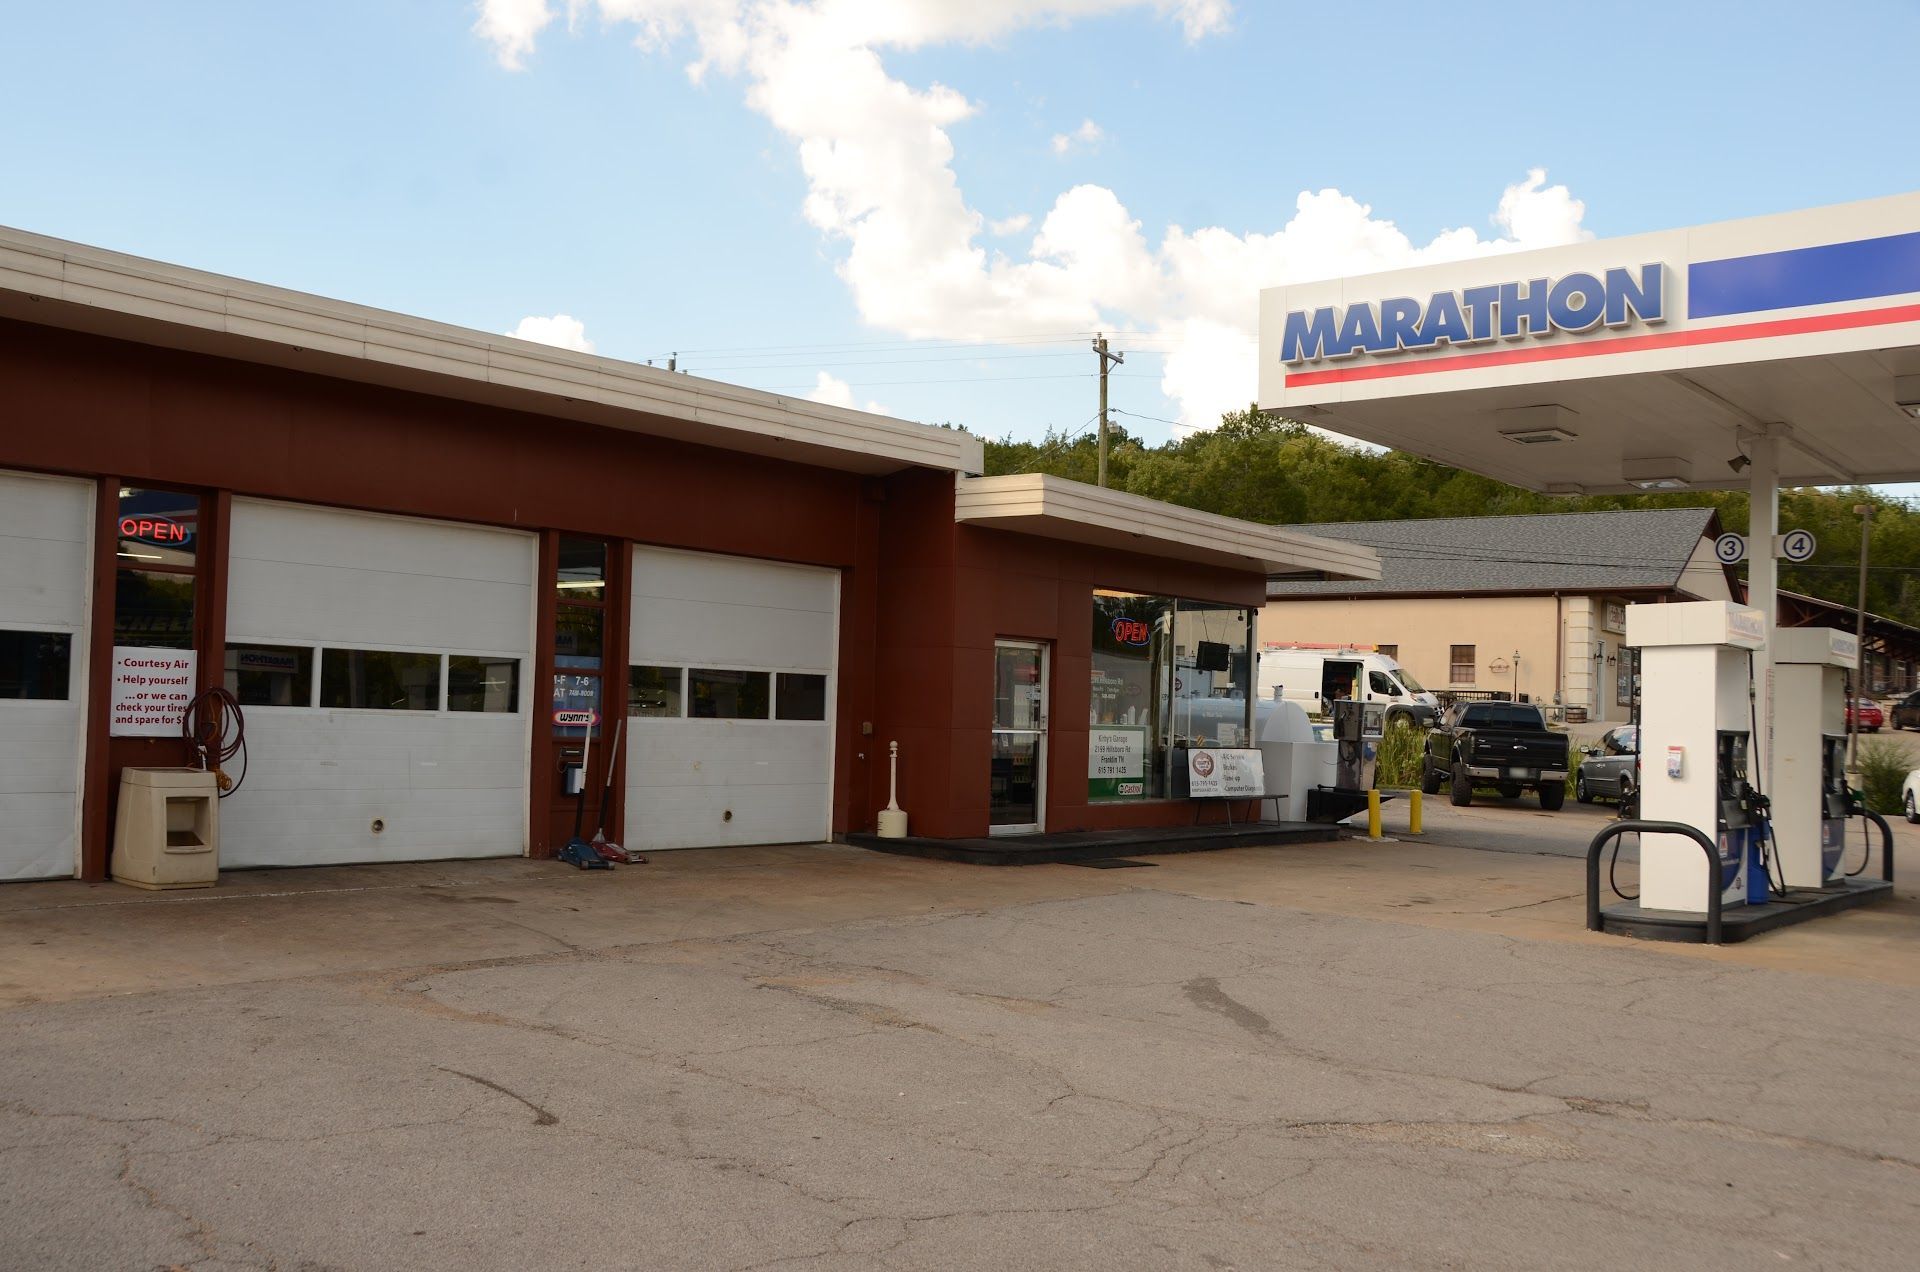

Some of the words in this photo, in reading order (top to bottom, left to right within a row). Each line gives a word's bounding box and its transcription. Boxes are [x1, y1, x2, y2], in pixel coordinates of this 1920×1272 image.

[1280, 261, 1667, 363] MARATHON
[121, 518, 185, 542] OPEN
[1723, 540, 1736, 556] 3
[1791, 537, 1805, 552] 4
[1116, 622, 1147, 641] OPEN
[124, 658, 171, 670] Courtesy
[174, 660, 189, 669] Air
[123, 675, 146, 686] Help
[148, 676, 189, 686] yourself
[575, 676, 589, 686] 7-6
[553, 688, 566, 698] AT
[116, 703, 142, 712] check
[144, 704, 165, 714] your
[167, 704, 188, 713] tires
[115, 715, 133, 724] and
[135, 716, 159, 726] spare
[162, 716, 175, 724] for
[1113, 735, 1128, 743] Garage
[1100, 755, 1117, 763] Franklin
[1118, 755, 1125, 763] TN
[1124, 784, 1142, 794] Castrol
